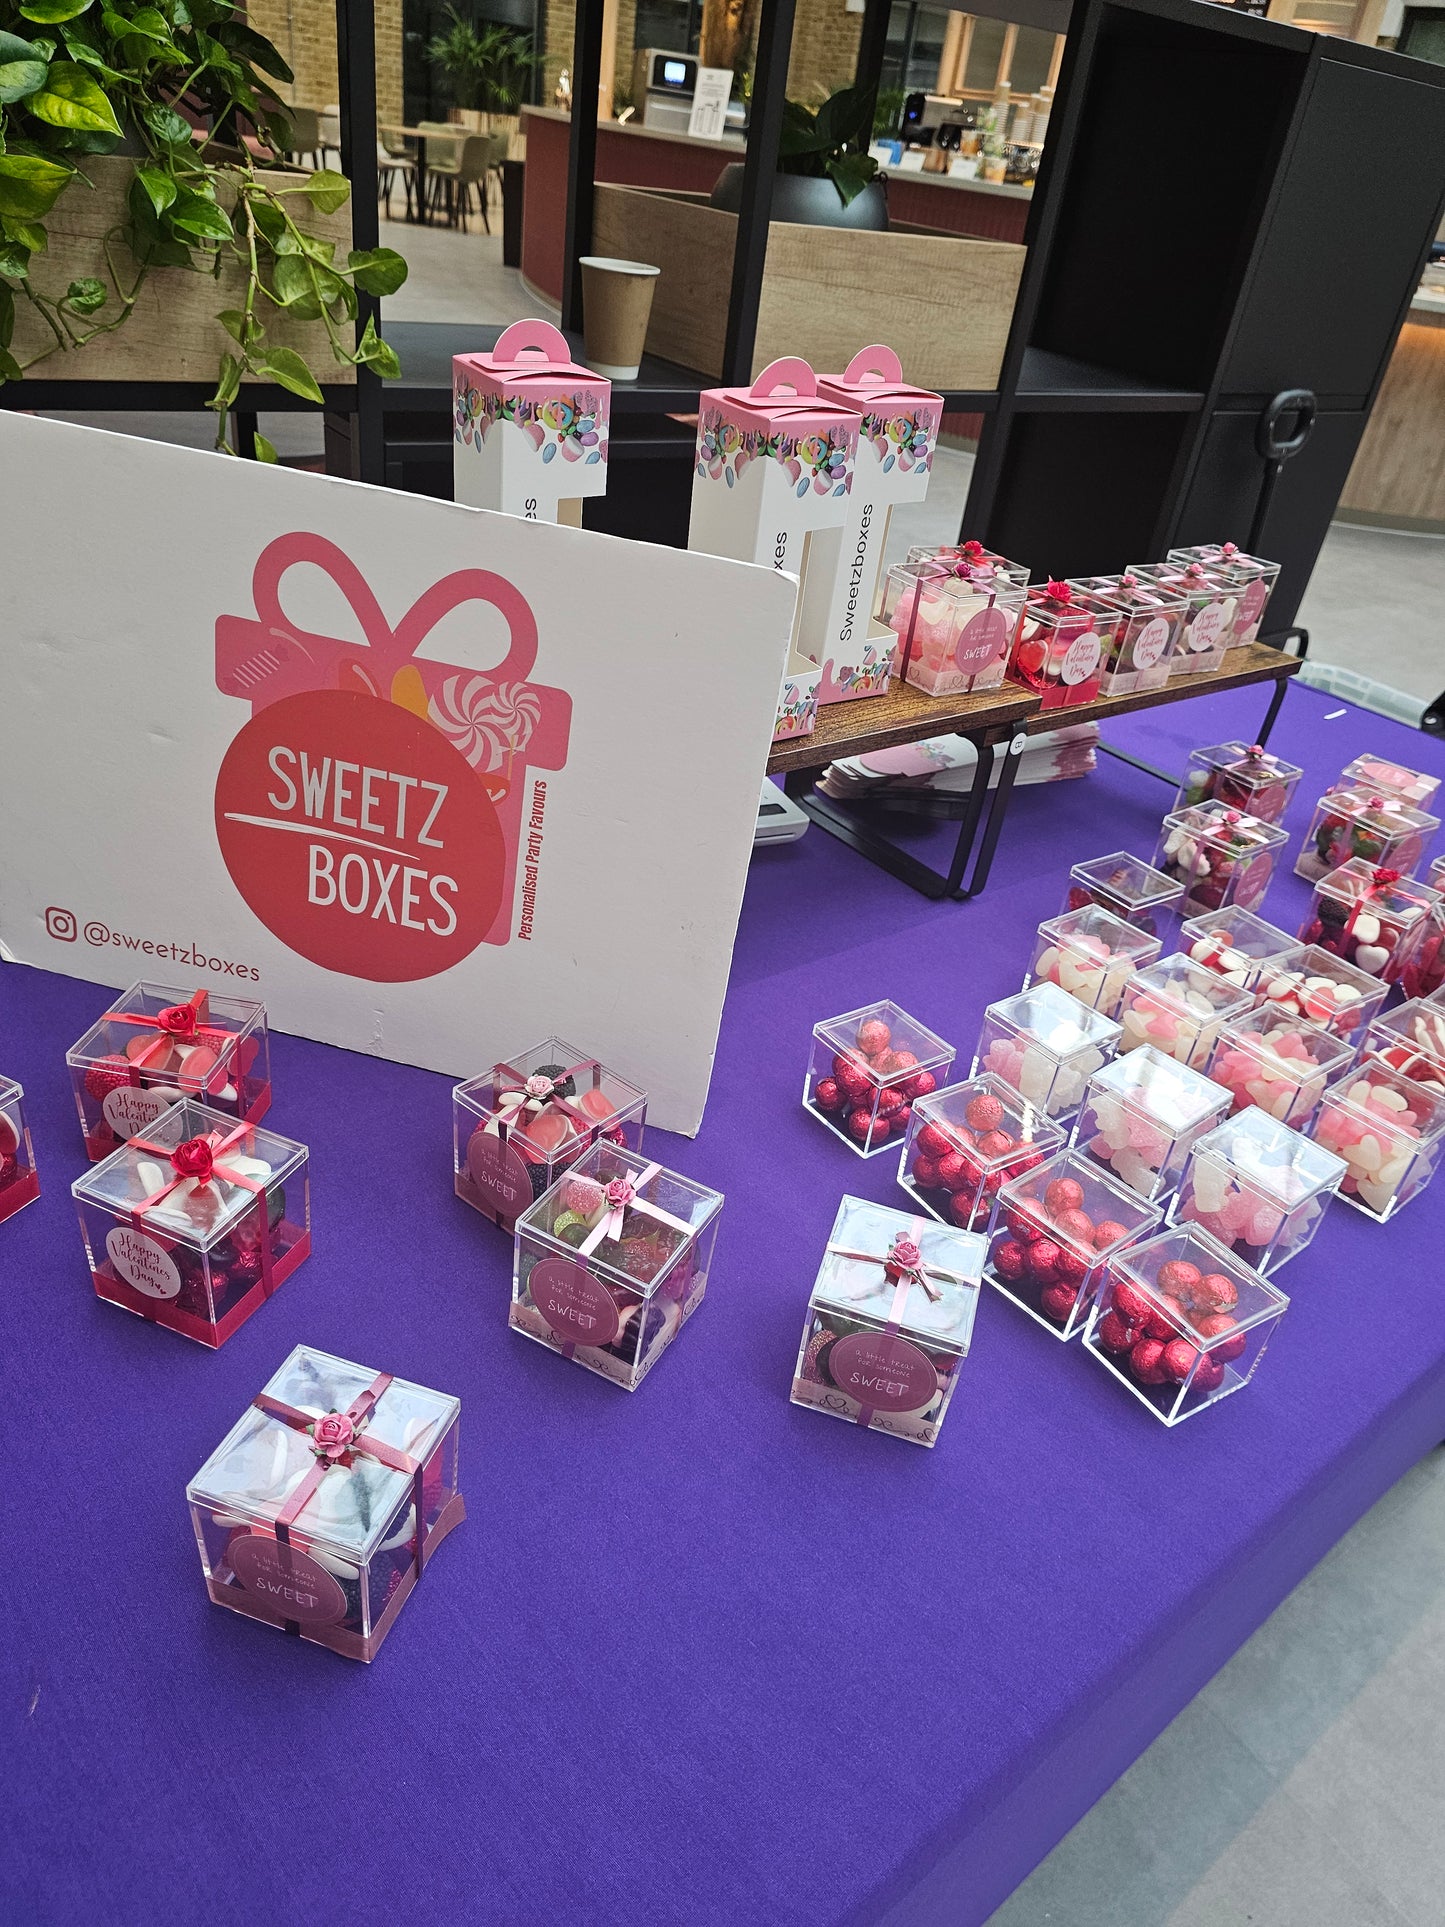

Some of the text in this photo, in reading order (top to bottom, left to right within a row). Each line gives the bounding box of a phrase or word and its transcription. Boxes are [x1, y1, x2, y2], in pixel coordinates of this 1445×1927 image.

[840, 503, 873, 641] Sweetzboxes
[963, 643, 993, 660] SWEET
[267, 745, 449, 849] SWEETZ
[518, 779, 547, 941] Personalised Party Favours
[307, 844, 459, 936] BOXES
[83, 921, 260, 982] @sweetzboxes
[116, 1093, 160, 1114] Happy
[481, 1170, 518, 1201] SWEET
[111, 1240, 170, 1280] Valentines
[119, 1232, 161, 1263] Happy
[130, 1264, 155, 1287] Day
[547, 1299, 597, 1329] SWEET
[849, 1371, 910, 1397] SWEET
[256, 1576, 319, 1608] SWEET
